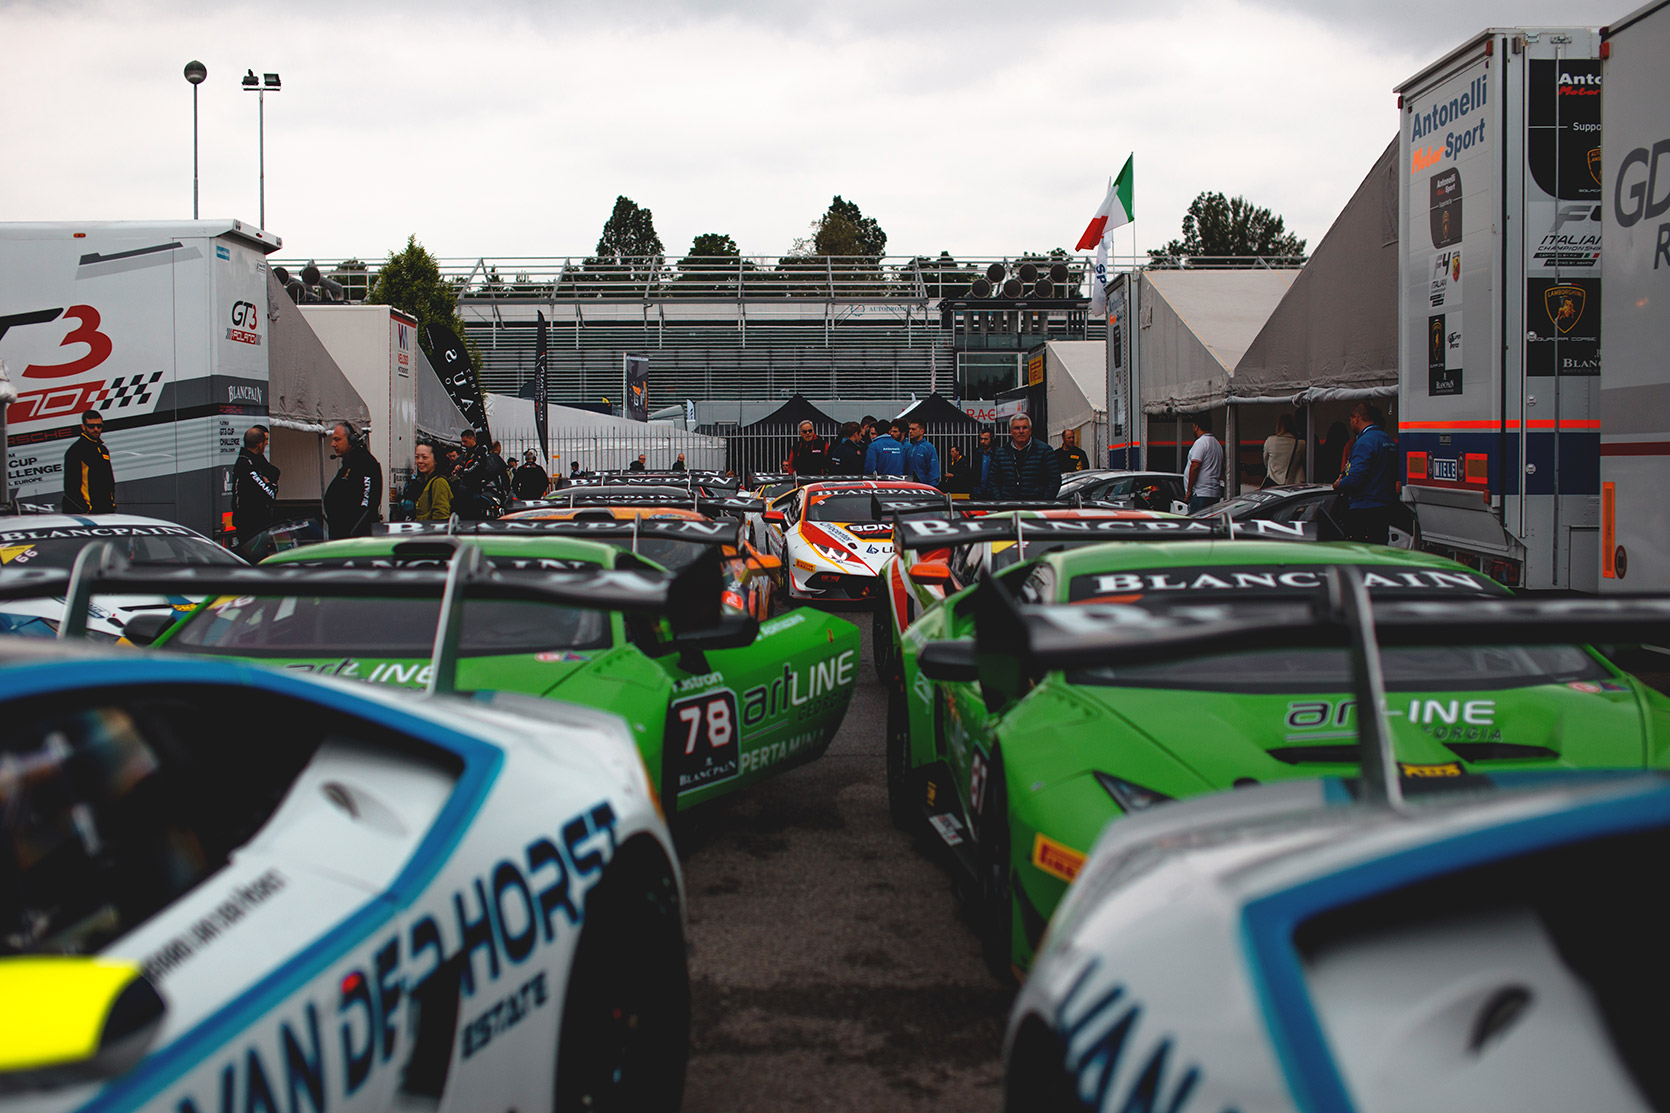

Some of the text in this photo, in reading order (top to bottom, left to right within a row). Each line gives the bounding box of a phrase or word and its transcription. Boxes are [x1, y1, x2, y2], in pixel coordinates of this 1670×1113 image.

[1411, 74, 1487, 143] Antonelli
[231, 300, 258, 330] GT3
[228, 385, 262, 404] BLANCPAIN
[8, 464, 63, 479] LLENGE
[9, 457, 37, 468] CUP
[568, 476, 733, 485] BLANCPAIN
[0, 526, 190, 542] BLANCPAIN
[384, 521, 729, 535] BLANCPAIN
[902, 519, 1308, 537] BLANCPAIN
[1093, 571, 1485, 593] BLANCAIN
[744, 650, 854, 728] artLINE
[679, 698, 733, 754] 78
[679, 759, 737, 787] BLANCPAIN
[460, 971, 551, 1060] ESTATE
